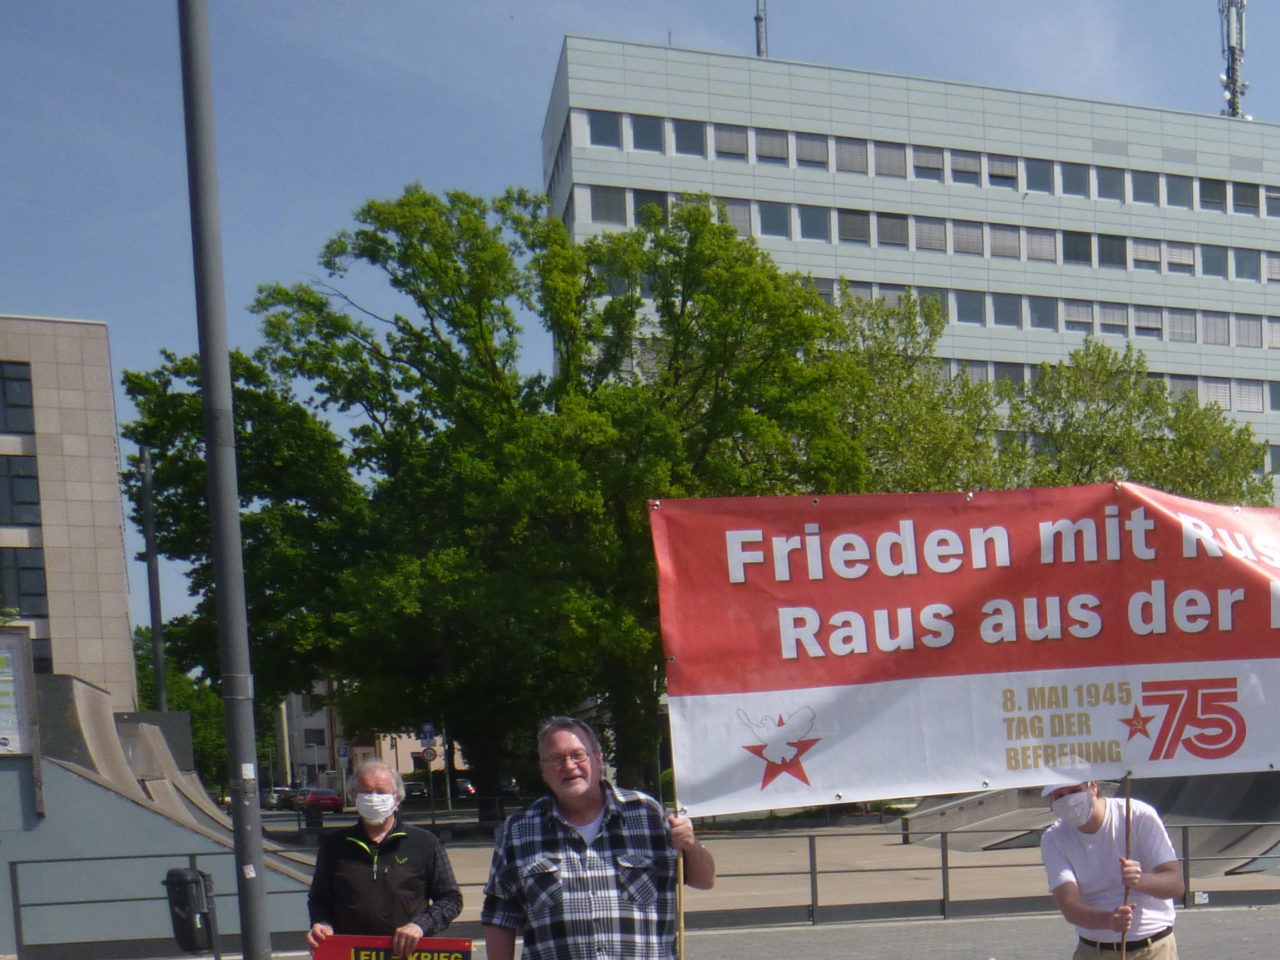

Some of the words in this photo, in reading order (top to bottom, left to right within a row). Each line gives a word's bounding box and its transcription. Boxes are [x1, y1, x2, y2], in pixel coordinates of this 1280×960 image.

[726, 520, 1011, 583] Frieden
[1039, 505, 1156, 563] mit
[778, 604, 955, 659] Raus
[979, 594, 1103, 643] aus
[1128, 580, 1245, 636] der
[1002, 688, 1022, 713] 8.
[1027, 685, 1069, 711] MAI
[1073, 681, 1133, 708] 1945
[1002, 715, 1045, 741] TAG
[1049, 712, 1092, 737] DER
[1141, 677, 1247, 761] 75
